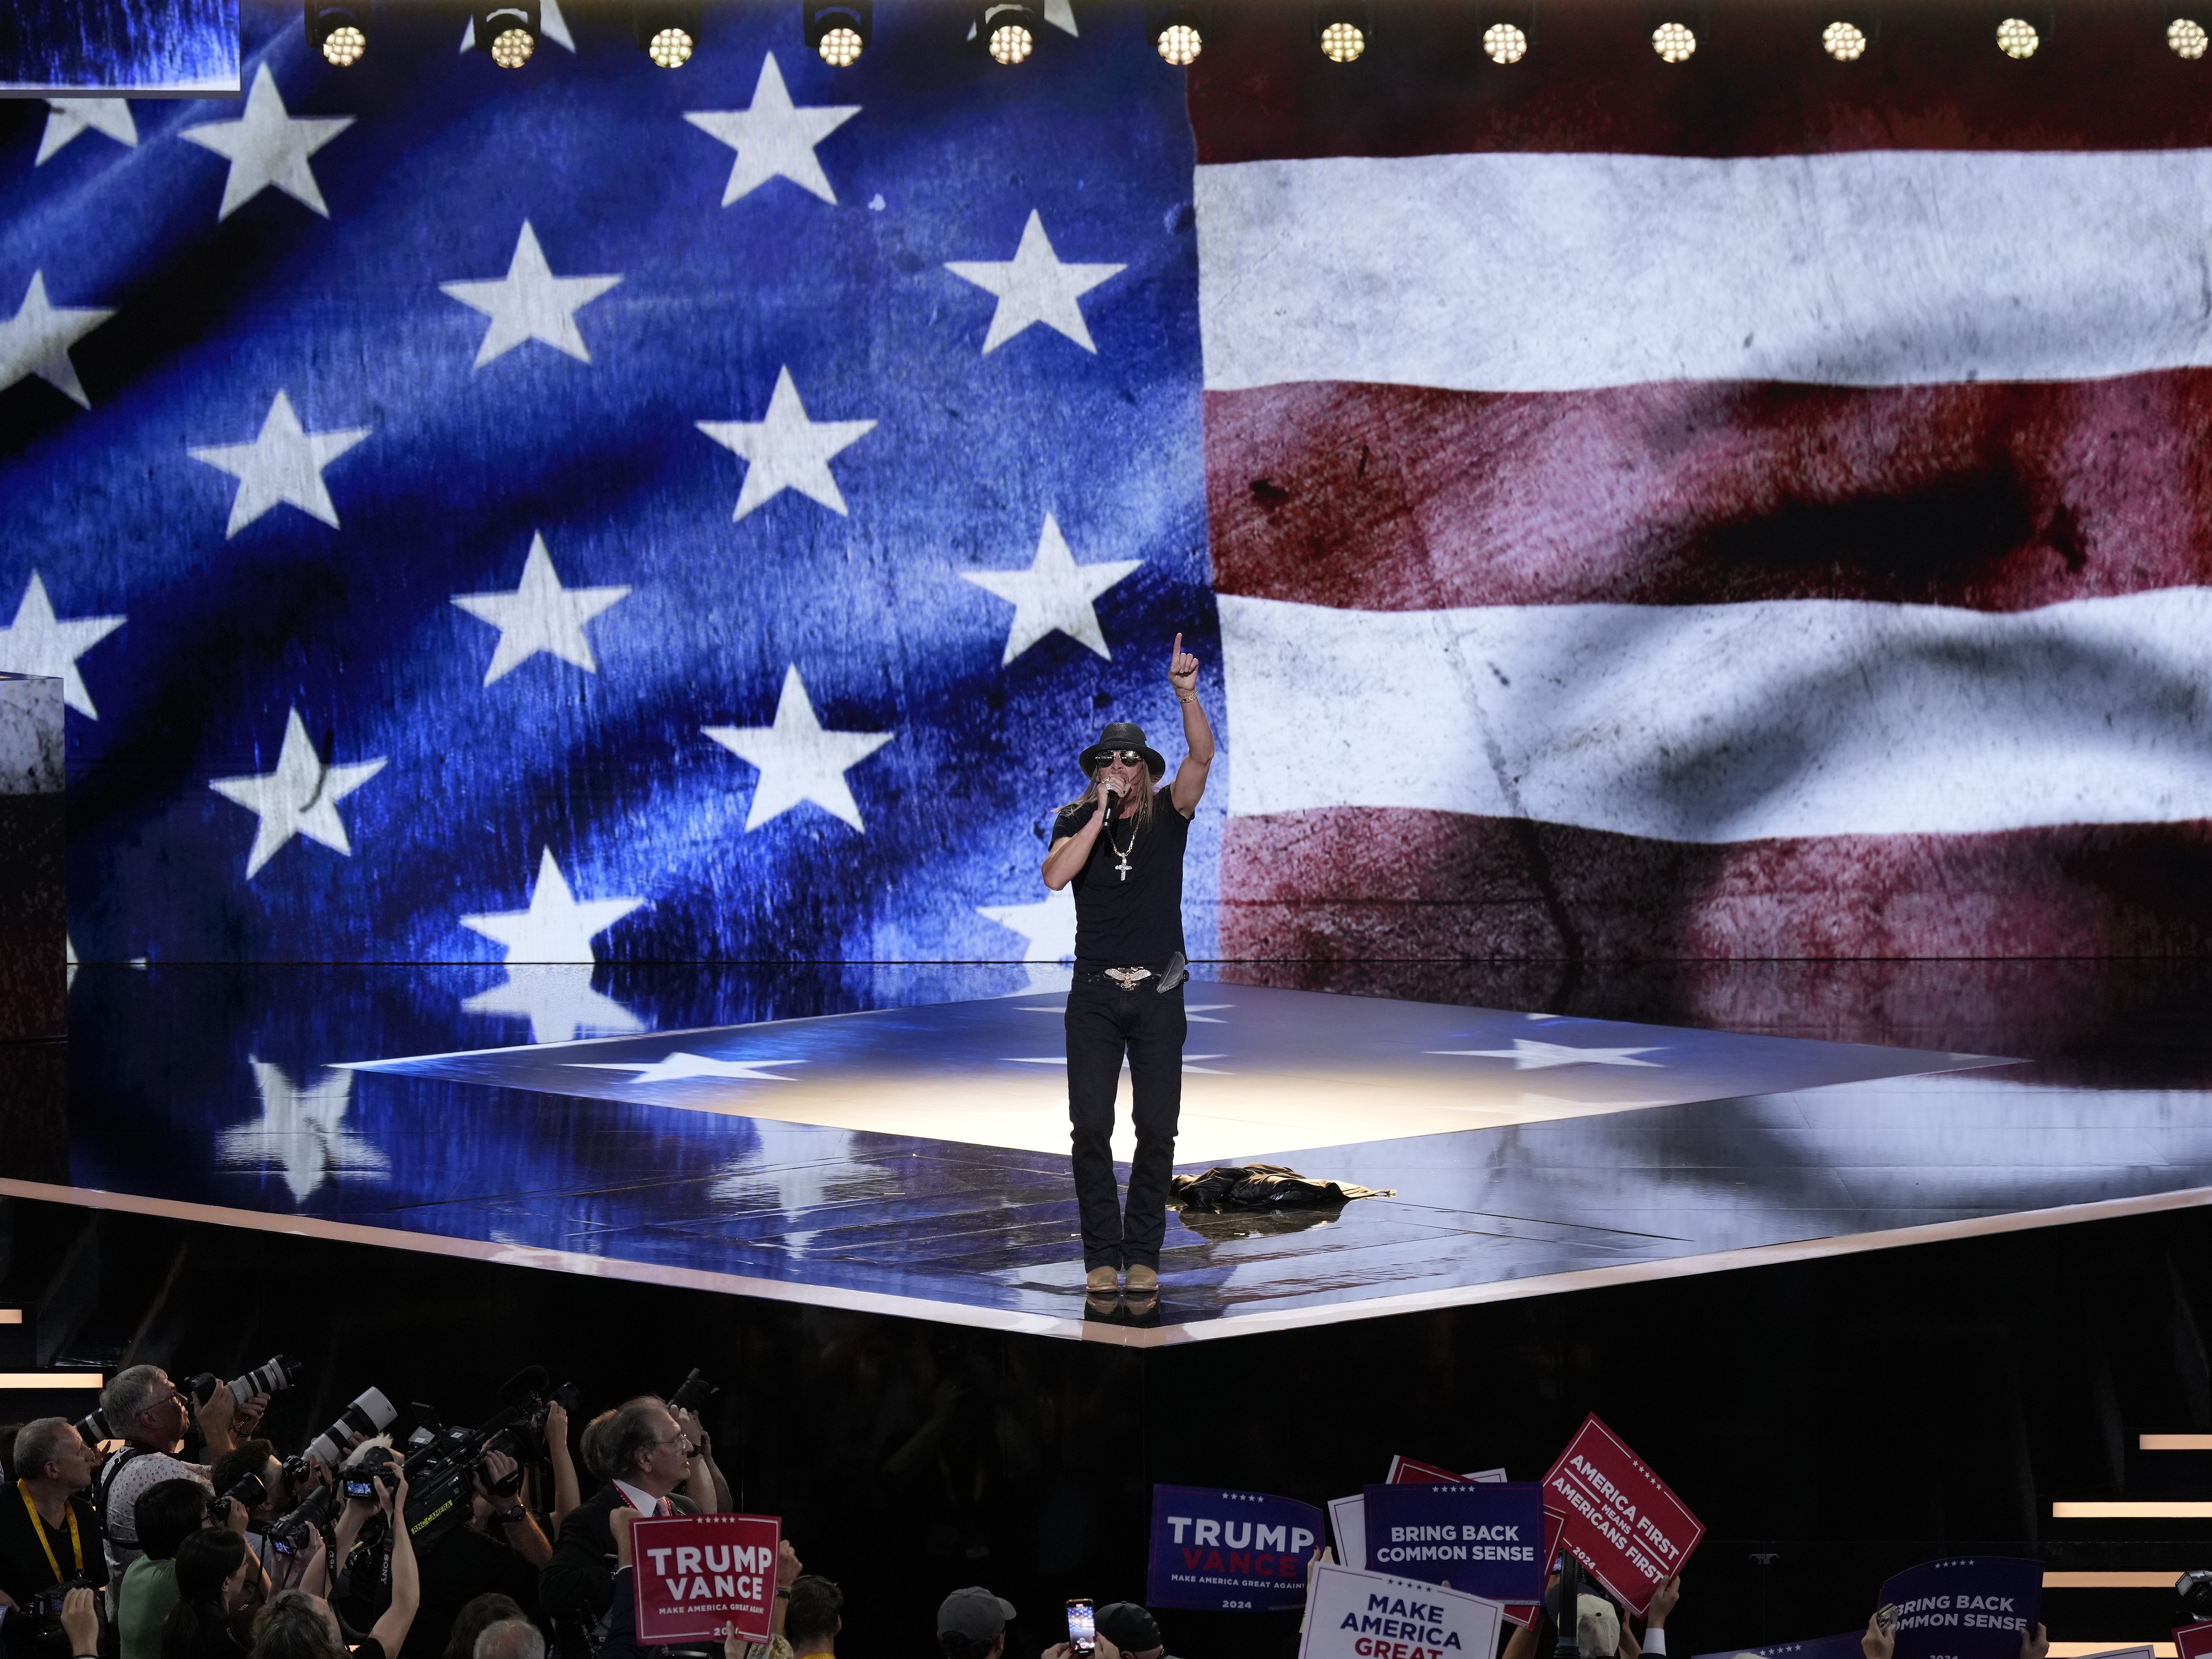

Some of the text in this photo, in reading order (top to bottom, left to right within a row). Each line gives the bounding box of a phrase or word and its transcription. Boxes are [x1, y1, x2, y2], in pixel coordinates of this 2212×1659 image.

[448, 1476, 459, 1486] SONY
[413, 1502, 451, 1533] RNC CAMERA
[1570, 1455, 1679, 1561] AMERICA FIRST
[1601, 1503, 1632, 1534] MEANS
[1168, 1517, 1314, 1553] TRUMP
[1391, 1525, 1519, 1542] BRING BACK
[1552, 1477, 1665, 1584] AMERICANS FIRST
[647, 1545, 772, 1576] TRUMP
[1182, 1548, 1297, 1578] VANCE
[1377, 1546, 1534, 1562] COMMON SENSE
[1573, 1546, 1596, 1570] 2024
[381, 1554, 389, 1585] SONY
[1199, 1576, 1239, 1586] AMERICA
[1242, 1580, 1271, 1588] GREAT
[665, 1575, 763, 1601] VANCE
[659, 1604, 764, 1614] MAKE AMERICA GREAT AGAIN!
[1222, 1600, 1252, 1609] 2024
[1367, 1594, 1444, 1624] MAKE
[1898, 1595, 2015, 1616] BRING BACK
[714, 1626, 739, 1636] 20
[1340, 1613, 1462, 1650] AMERICA
[1896, 1613, 2027, 1631] MMON SENSE
[1355, 1637, 1443, 1659] GREAT
